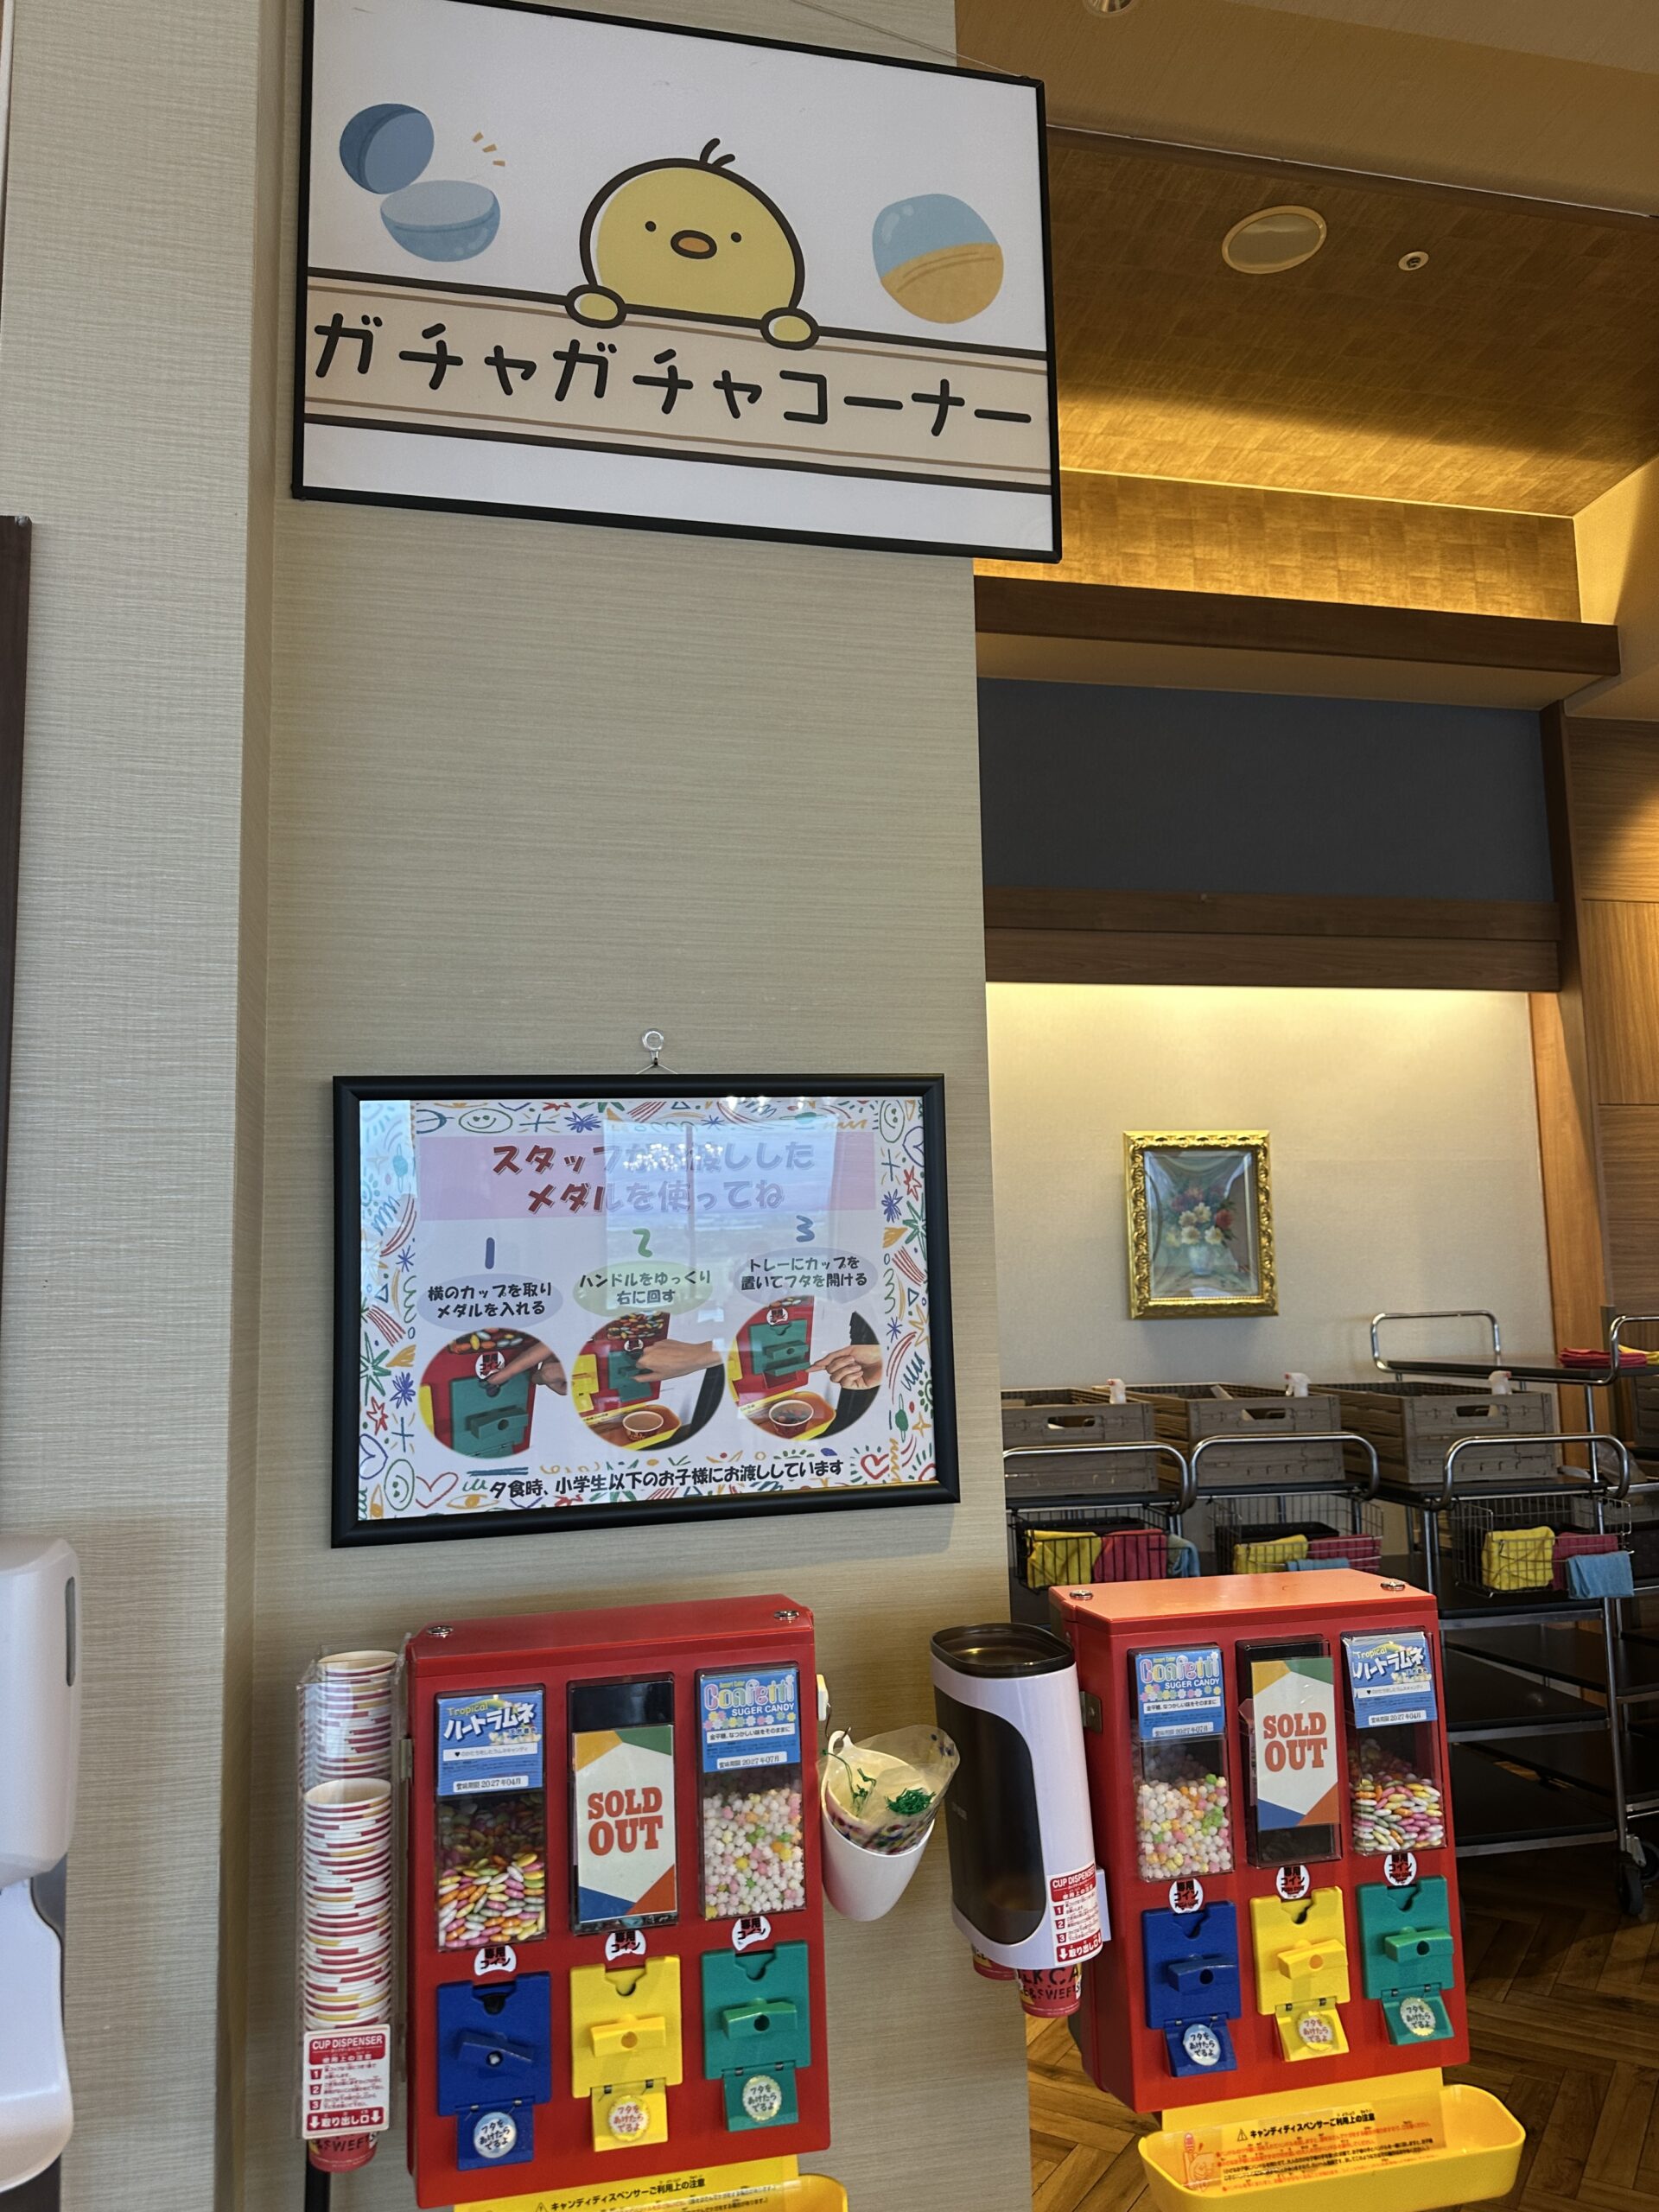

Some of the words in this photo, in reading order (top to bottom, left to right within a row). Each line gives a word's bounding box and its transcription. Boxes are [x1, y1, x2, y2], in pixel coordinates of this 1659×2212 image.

[315, 312, 1032, 436] ガチャガチャコーナー
[528, 1179, 785, 1214] メダルを使ってね
[796, 1215, 815, 1243] 3
[632, 1228, 653, 1257] 2
[485, 1237, 495, 1269] 1
[749, 1256, 860, 1273] トレーにカップを
[579, 1269, 711, 1288] ハンドルをゆっくり
[741, 1273, 868, 1291] 置いてフタを開ける
[428, 1282, 552, 1301] 横のカップを取り
[617, 1288, 676, 1306] 右に回す
[437, 1300, 546, 1319] メダルを入れる
[489, 1459, 844, 1499] 夕食時、小学生以下のお子様にお渡ししています
[1352, 1647, 1387, 1660] Tropical
[1140, 1651, 1219, 1683] Confetti
[1352, 1647, 1424, 1681] ハートラムネ
[704, 1675, 794, 1711] Confetti
[1165, 1681, 1192, 1689] SUGER
[1194, 1678, 1219, 1687] CANDY
[447, 1701, 488, 1716] Tropical
[732, 1706, 762, 1716] SUGER
[765, 1703, 794, 1713] CANDY
[443, 1703, 536, 1740] ハートラムネ
[1263, 1712, 1326, 1739] SOLD
[1265, 1738, 1327, 1772] OUT
[588, 1787, 662, 1820] SOLD
[588, 1815, 663, 1856] OUT
[1052, 1878, 1067, 1889] CUP
[312, 2039, 330, 2050] CUP
[332, 2035, 383, 2048] DISPENSER
[321, 2113, 370, 2127] 取り出し口
[481, 2120, 503, 2133] フタを
[480, 2126, 510, 2145] あけたら
[485, 2137, 507, 2150] でるよ
[551, 2178, 705, 2211] キャンディディスペンサーご利用上の注意
